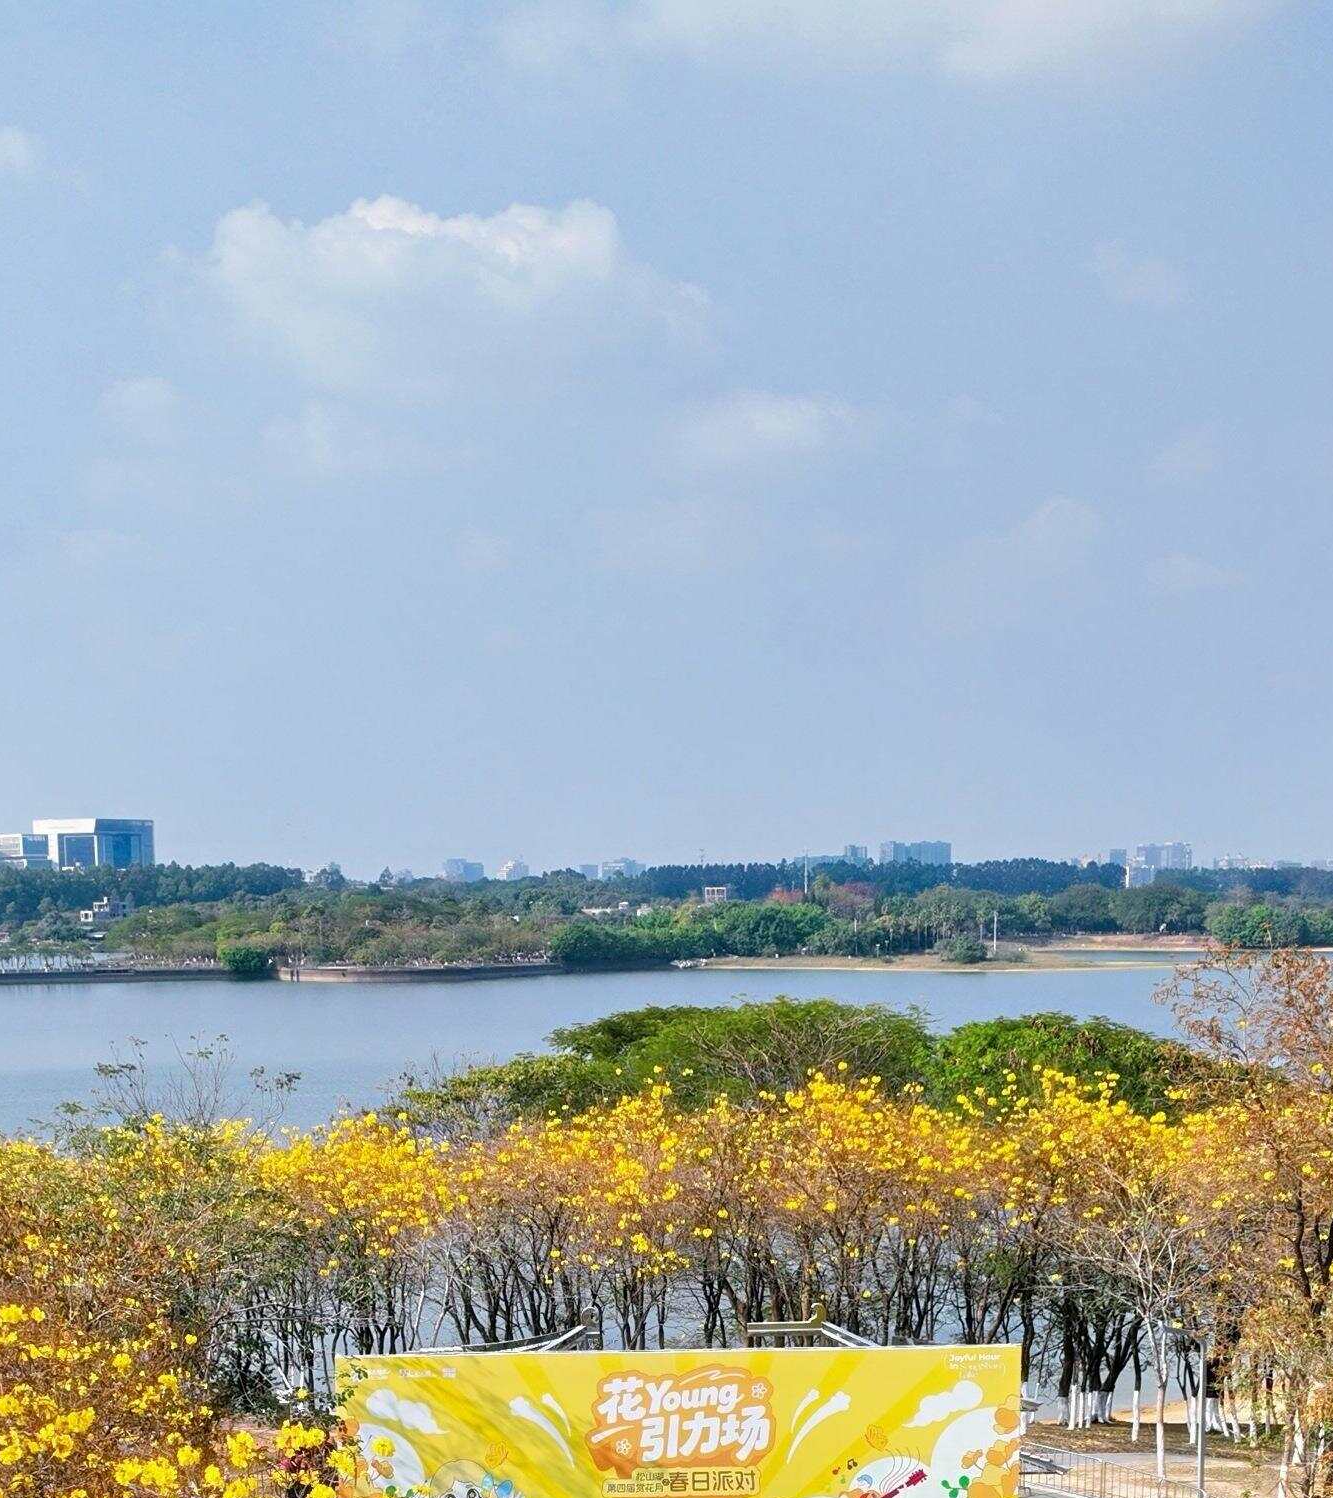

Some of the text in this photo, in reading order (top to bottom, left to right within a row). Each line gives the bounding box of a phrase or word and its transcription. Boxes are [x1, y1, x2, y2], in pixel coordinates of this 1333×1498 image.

[949, 1354, 976, 1363] Joyful
[640, 1405, 771, 1462] 引力场
[669, 1471, 756, 1492] 春日派对
